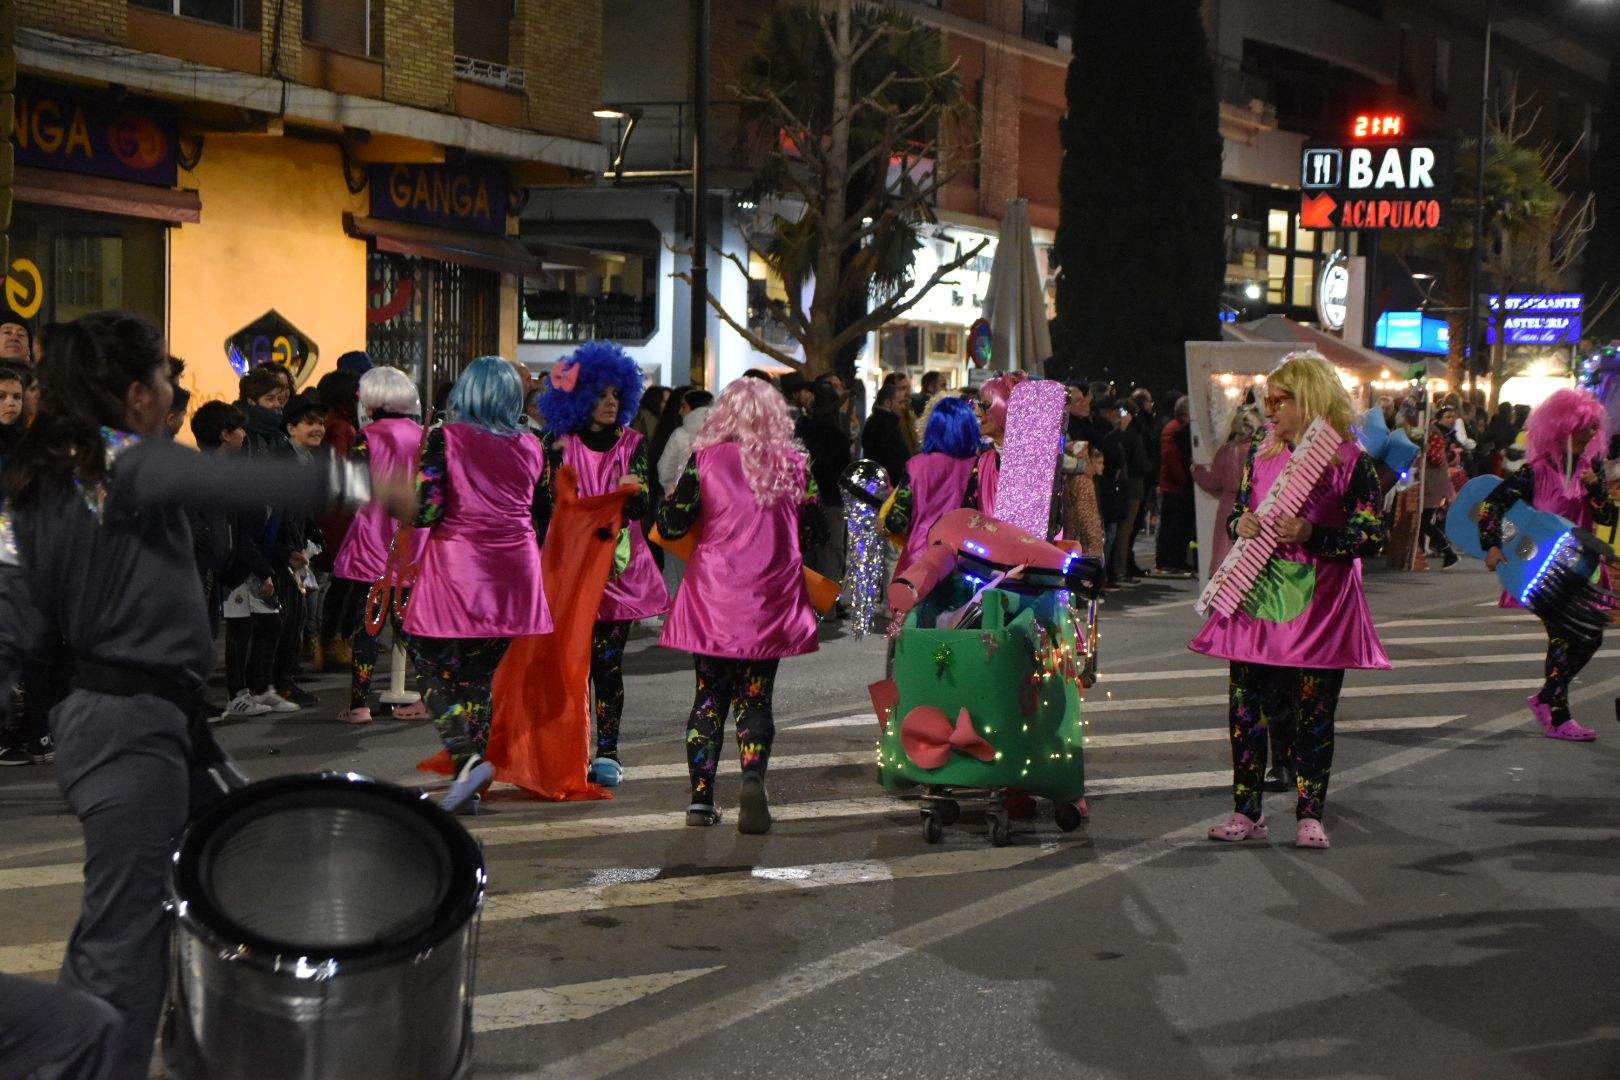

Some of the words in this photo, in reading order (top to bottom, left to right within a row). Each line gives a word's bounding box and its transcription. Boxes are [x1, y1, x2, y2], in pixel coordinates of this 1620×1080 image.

[1348, 147, 1435, 189] BAR
[388, 165, 491, 219] GANGA
[1340, 199, 1440, 229] ACAPULCO
